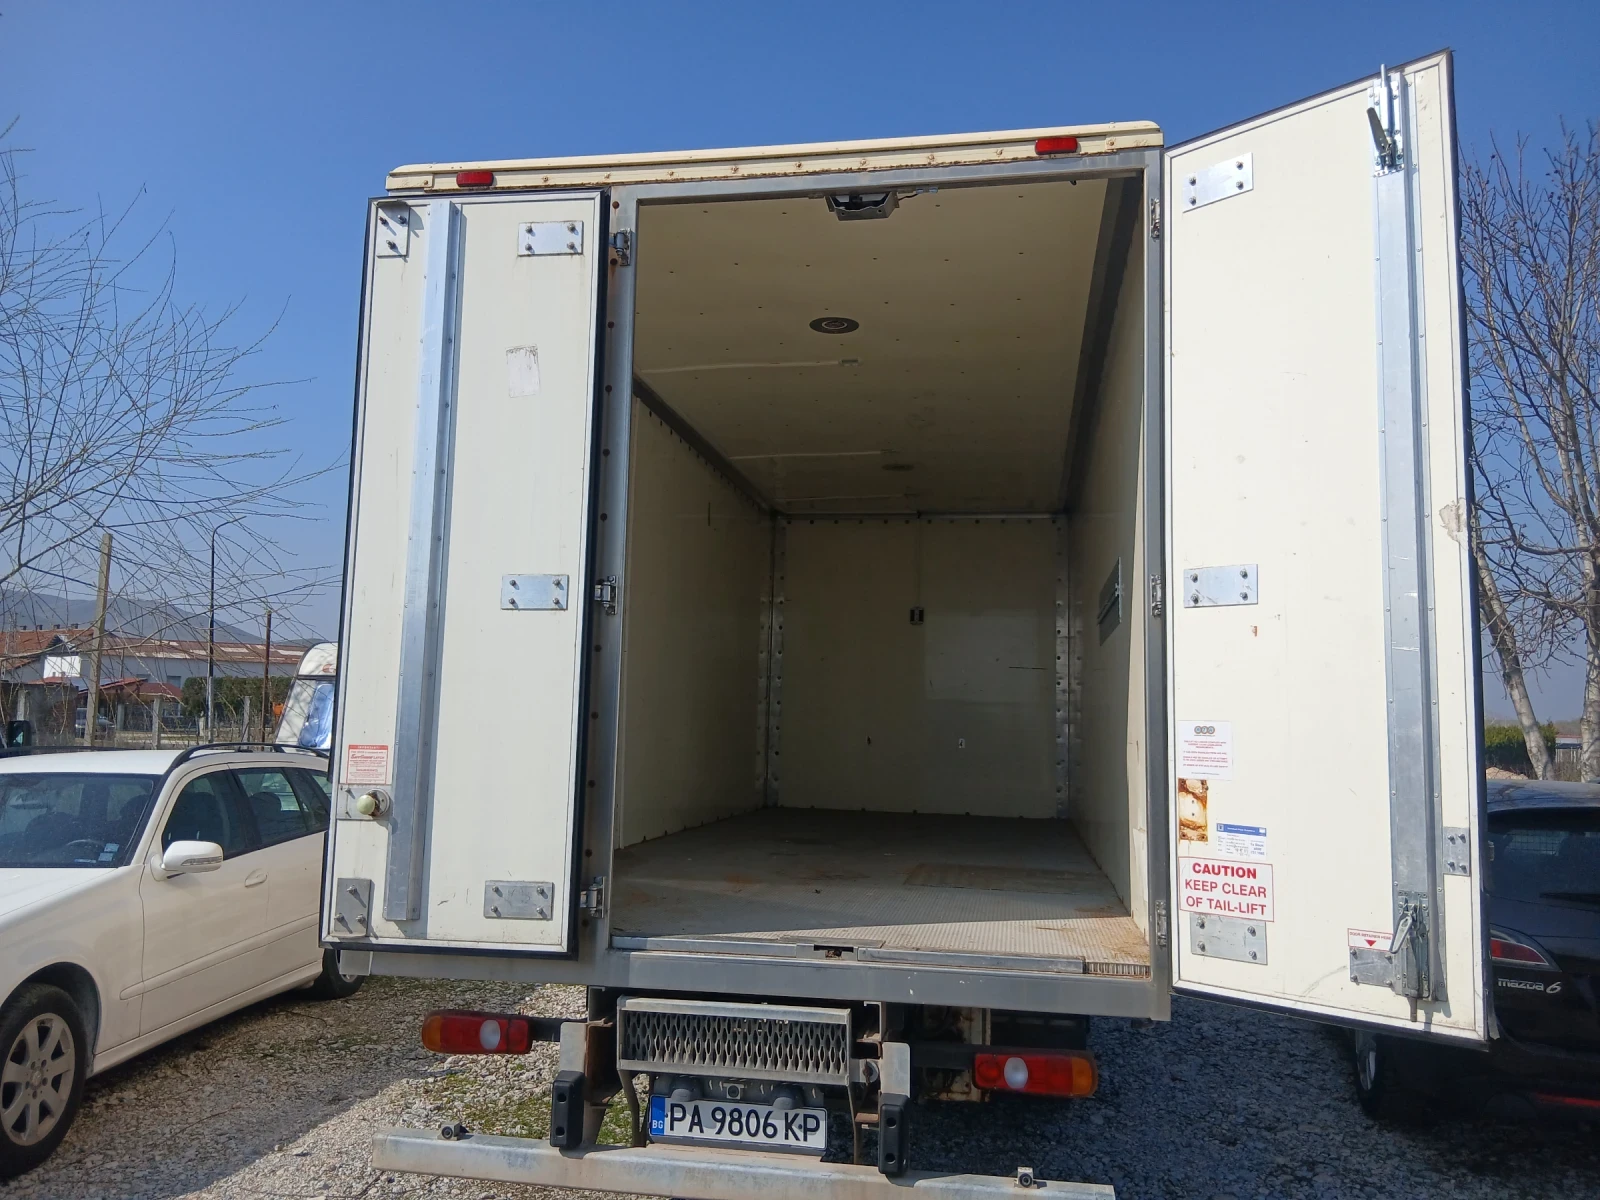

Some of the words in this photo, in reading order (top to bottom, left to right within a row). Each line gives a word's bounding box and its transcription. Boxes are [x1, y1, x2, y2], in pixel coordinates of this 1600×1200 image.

[1192, 862, 1257, 879] CAUTION
[1185, 879, 1218, 892] KEEP
[1222, 882, 1267, 898] CLEAR
[1186, 896, 1203, 907] OF
[1206, 898, 1267, 915] TAIL-LIFT
[652, 1120, 664, 1129] BG
[669, 1103, 704, 1134] PA
[711, 1106, 778, 1139] 9806
[784, 1111, 820, 1142] KP
